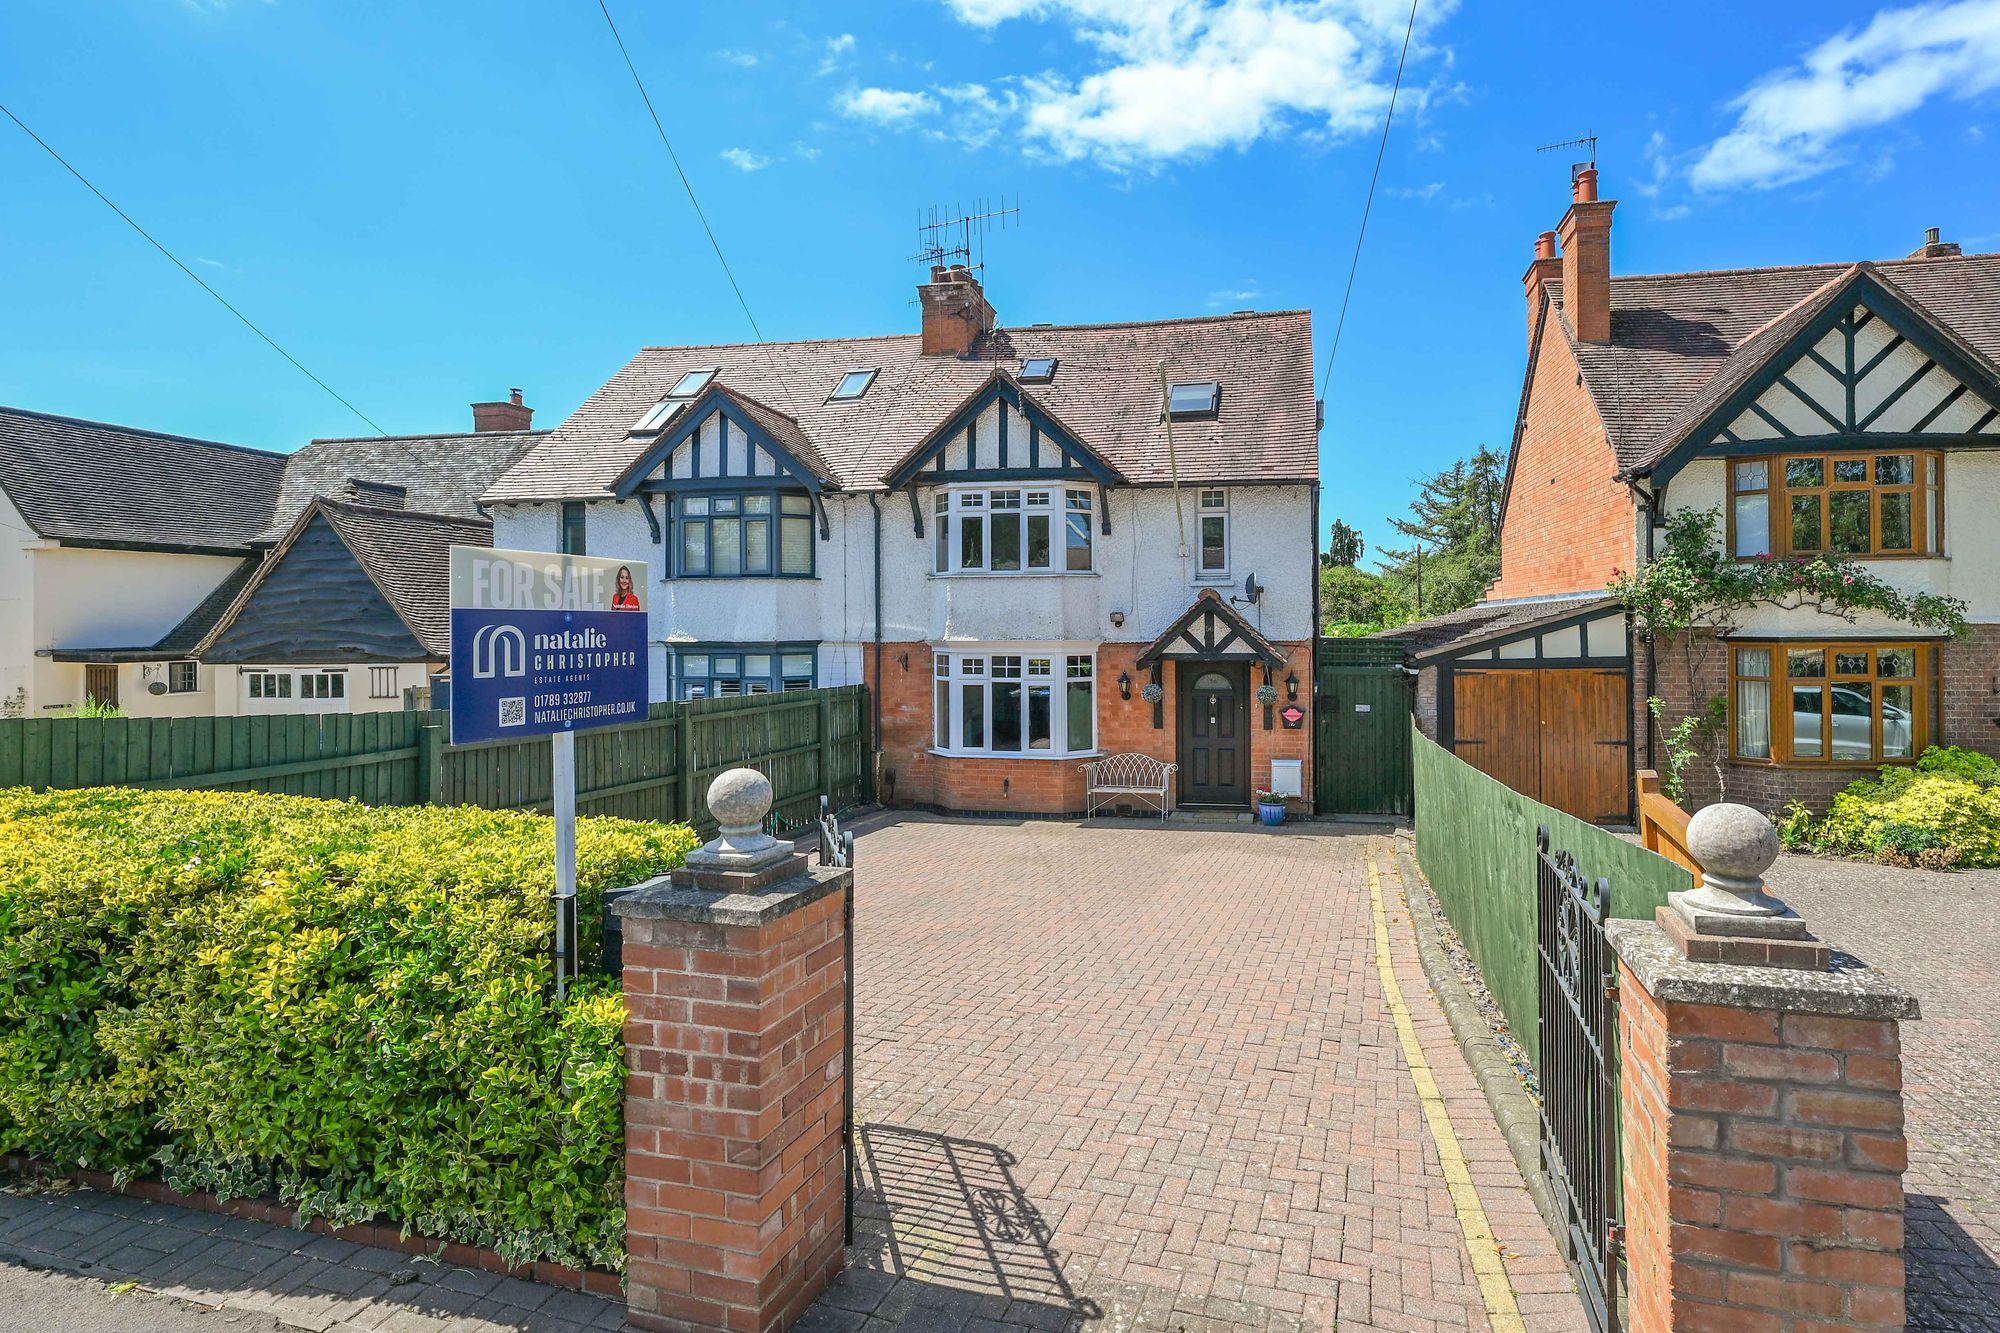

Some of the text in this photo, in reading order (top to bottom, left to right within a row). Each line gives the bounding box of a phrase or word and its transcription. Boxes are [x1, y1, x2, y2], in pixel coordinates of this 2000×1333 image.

[472, 559, 605, 610] FOR SALE
[534, 627, 607, 650] natalie
[534, 651, 635, 671] CHRISTOPHER
[534, 673, 590, 684] ESTATE AGENTS
[534, 691, 592, 708] 01789 332877
[534, 701, 636, 724] NATALIECHRISTOPHER.CO.UK
